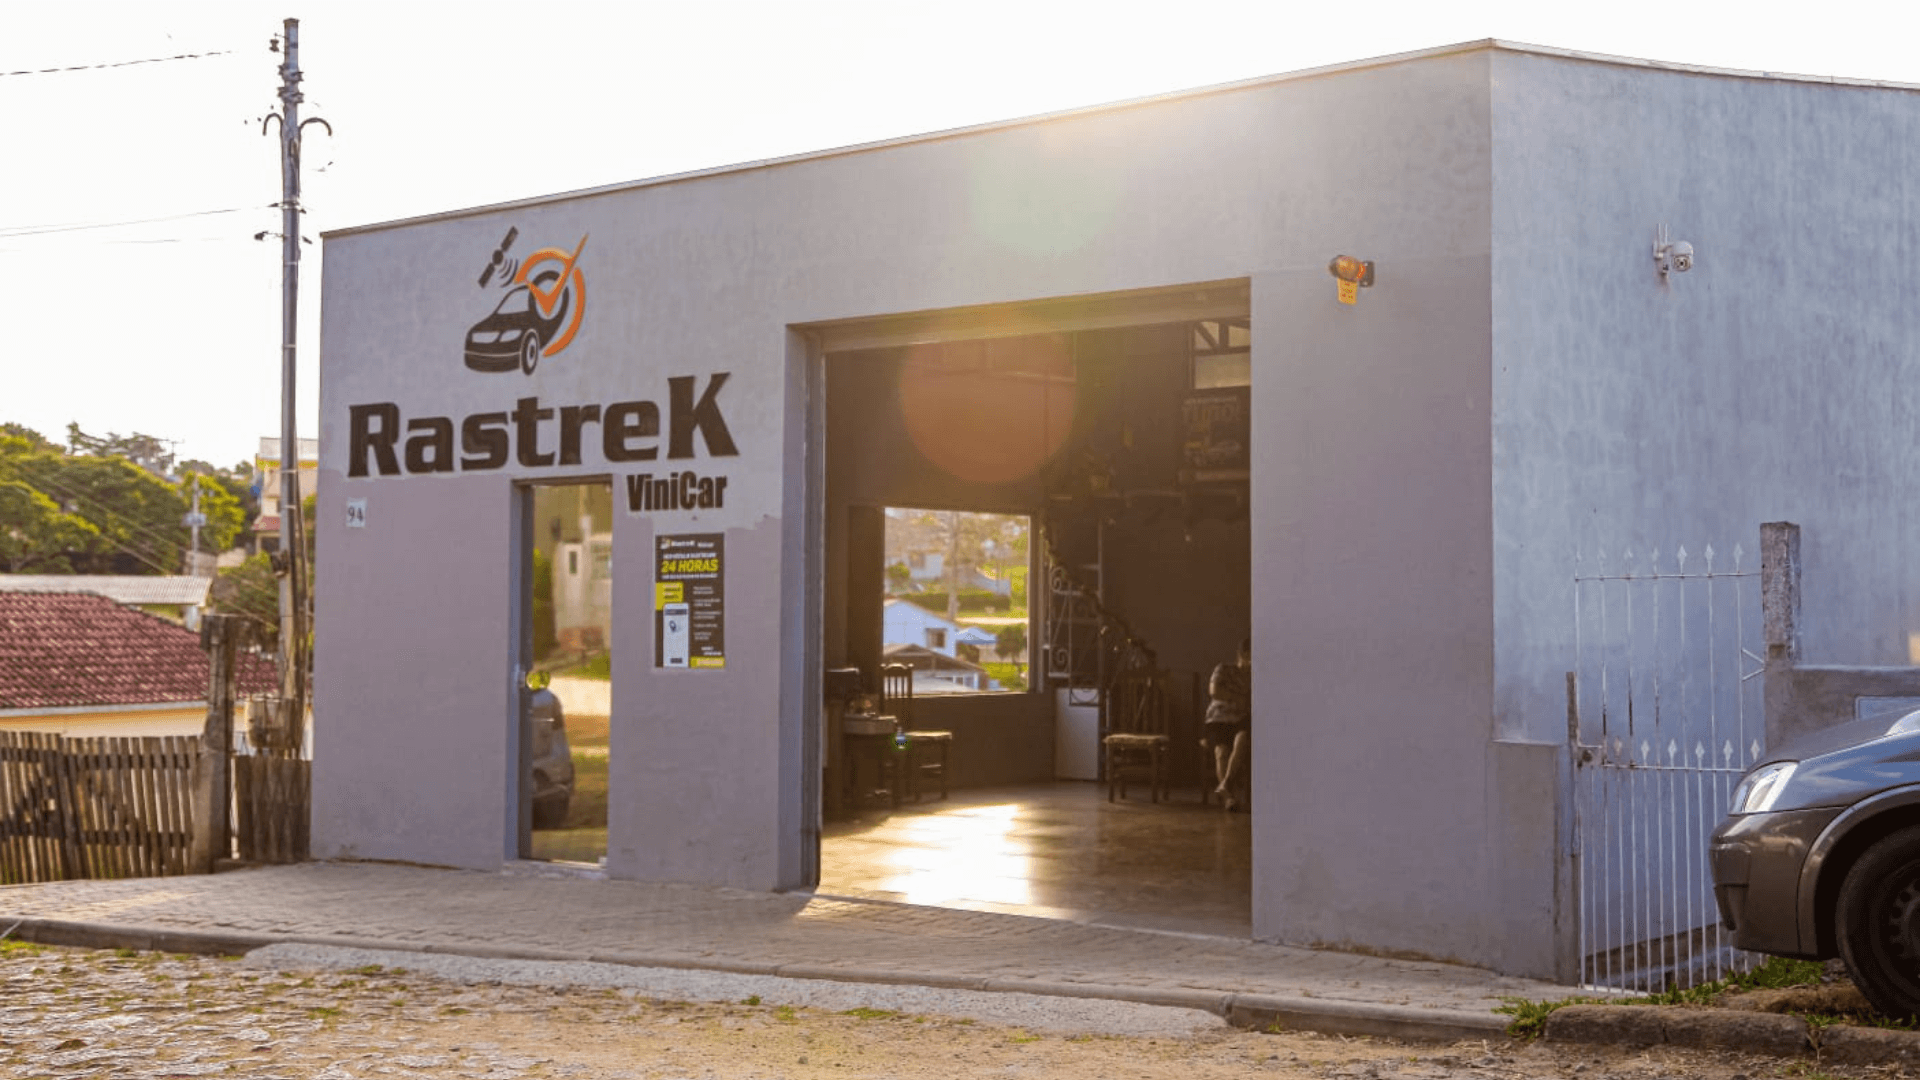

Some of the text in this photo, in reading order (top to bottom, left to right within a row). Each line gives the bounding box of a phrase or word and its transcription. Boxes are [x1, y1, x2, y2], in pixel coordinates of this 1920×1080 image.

[348, 372, 740, 478] RastreK
[627, 471, 728, 512] ViniCar
[348, 506, 364, 521] 94
[661, 558, 719, 573] 24 HORAS
